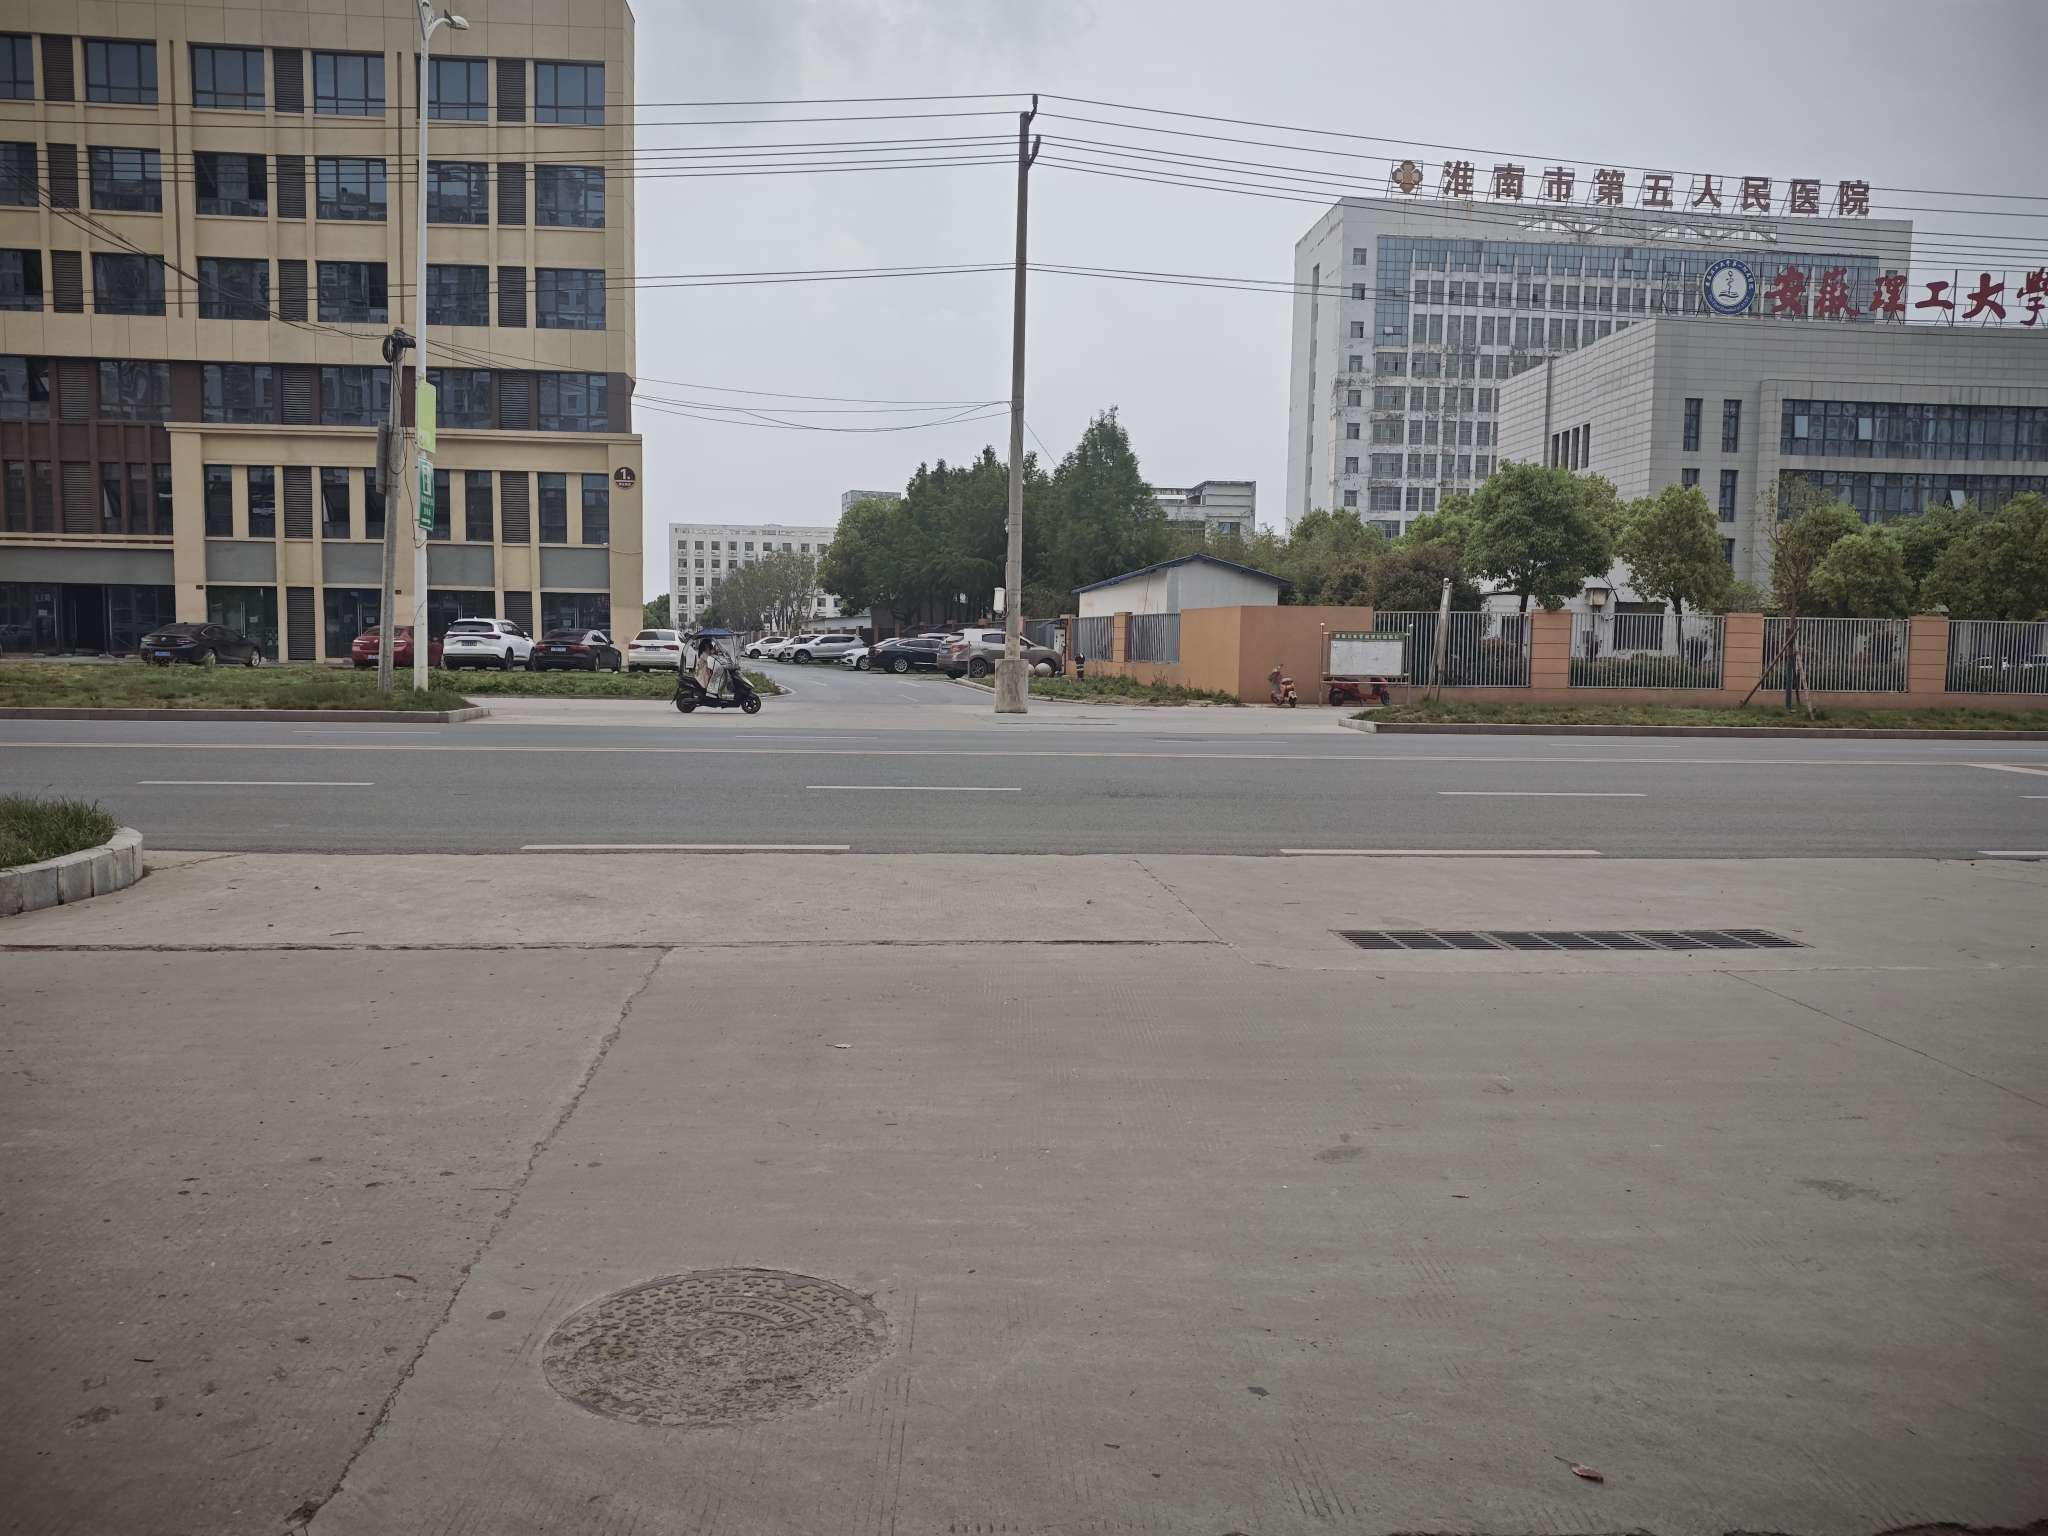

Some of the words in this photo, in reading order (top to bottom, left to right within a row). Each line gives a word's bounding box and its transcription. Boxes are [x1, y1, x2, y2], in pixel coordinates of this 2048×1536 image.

[1443, 159, 1871, 216] 淮南市第五人民医院
